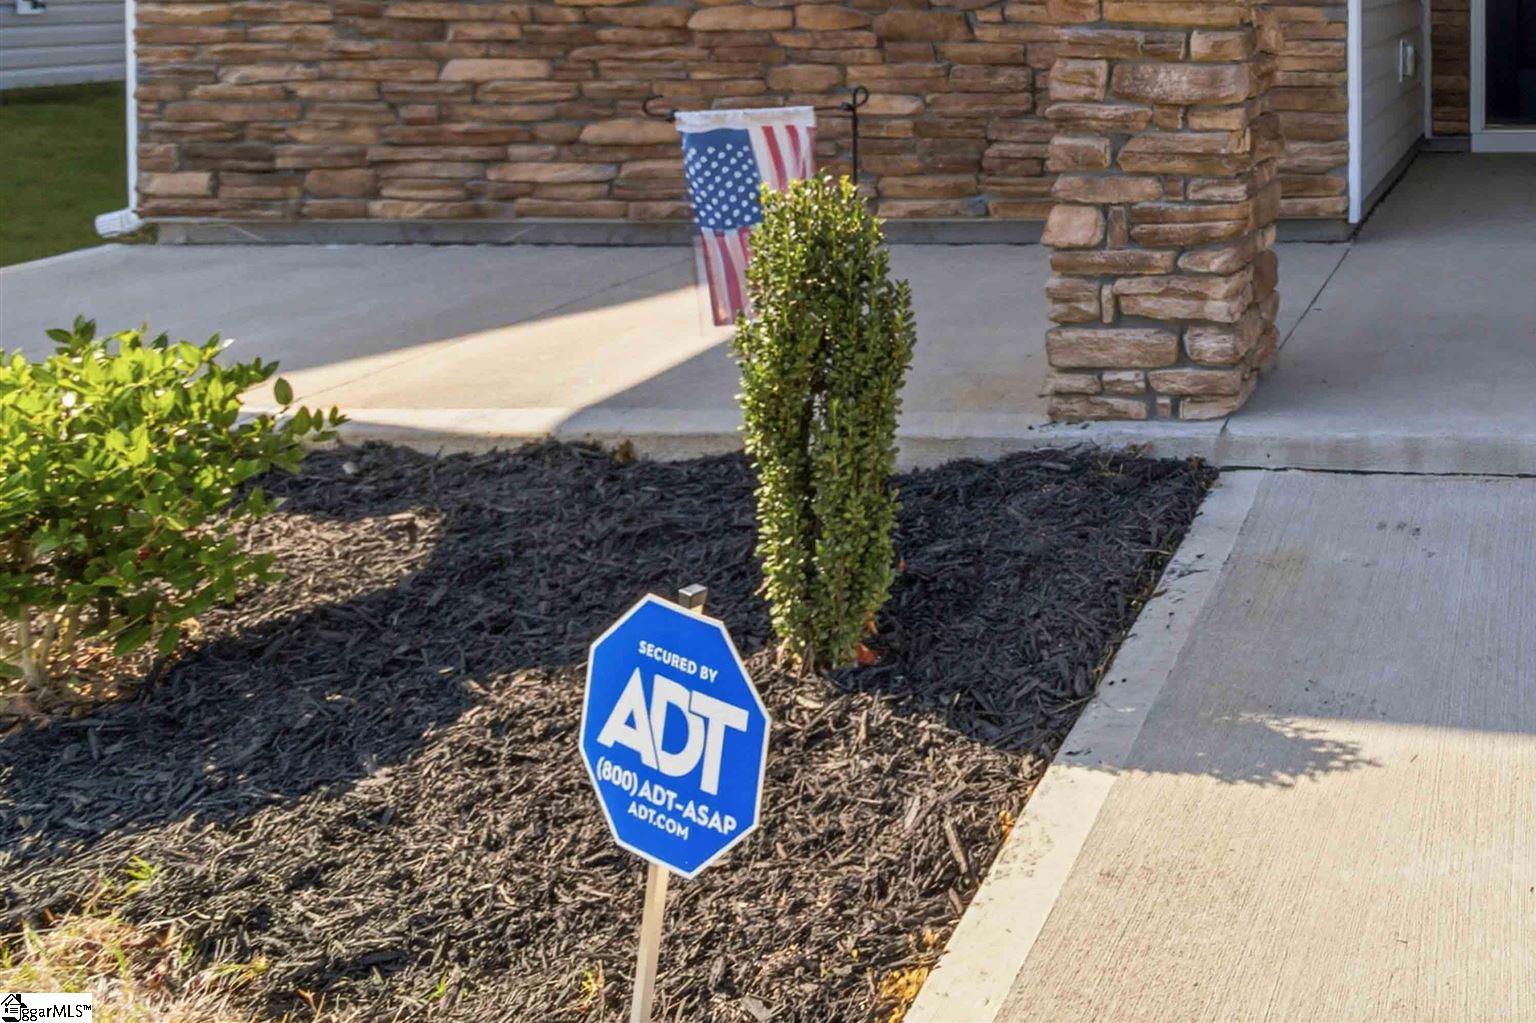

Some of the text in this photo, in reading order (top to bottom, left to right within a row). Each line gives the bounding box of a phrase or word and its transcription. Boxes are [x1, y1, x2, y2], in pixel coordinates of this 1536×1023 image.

[638, 640, 719, 683] SECURED BY
[596, 667, 749, 796] ADT
[596, 756, 738, 835] (800) ADT-ASAP
[627, 801, 690, 841] ADT.COM
